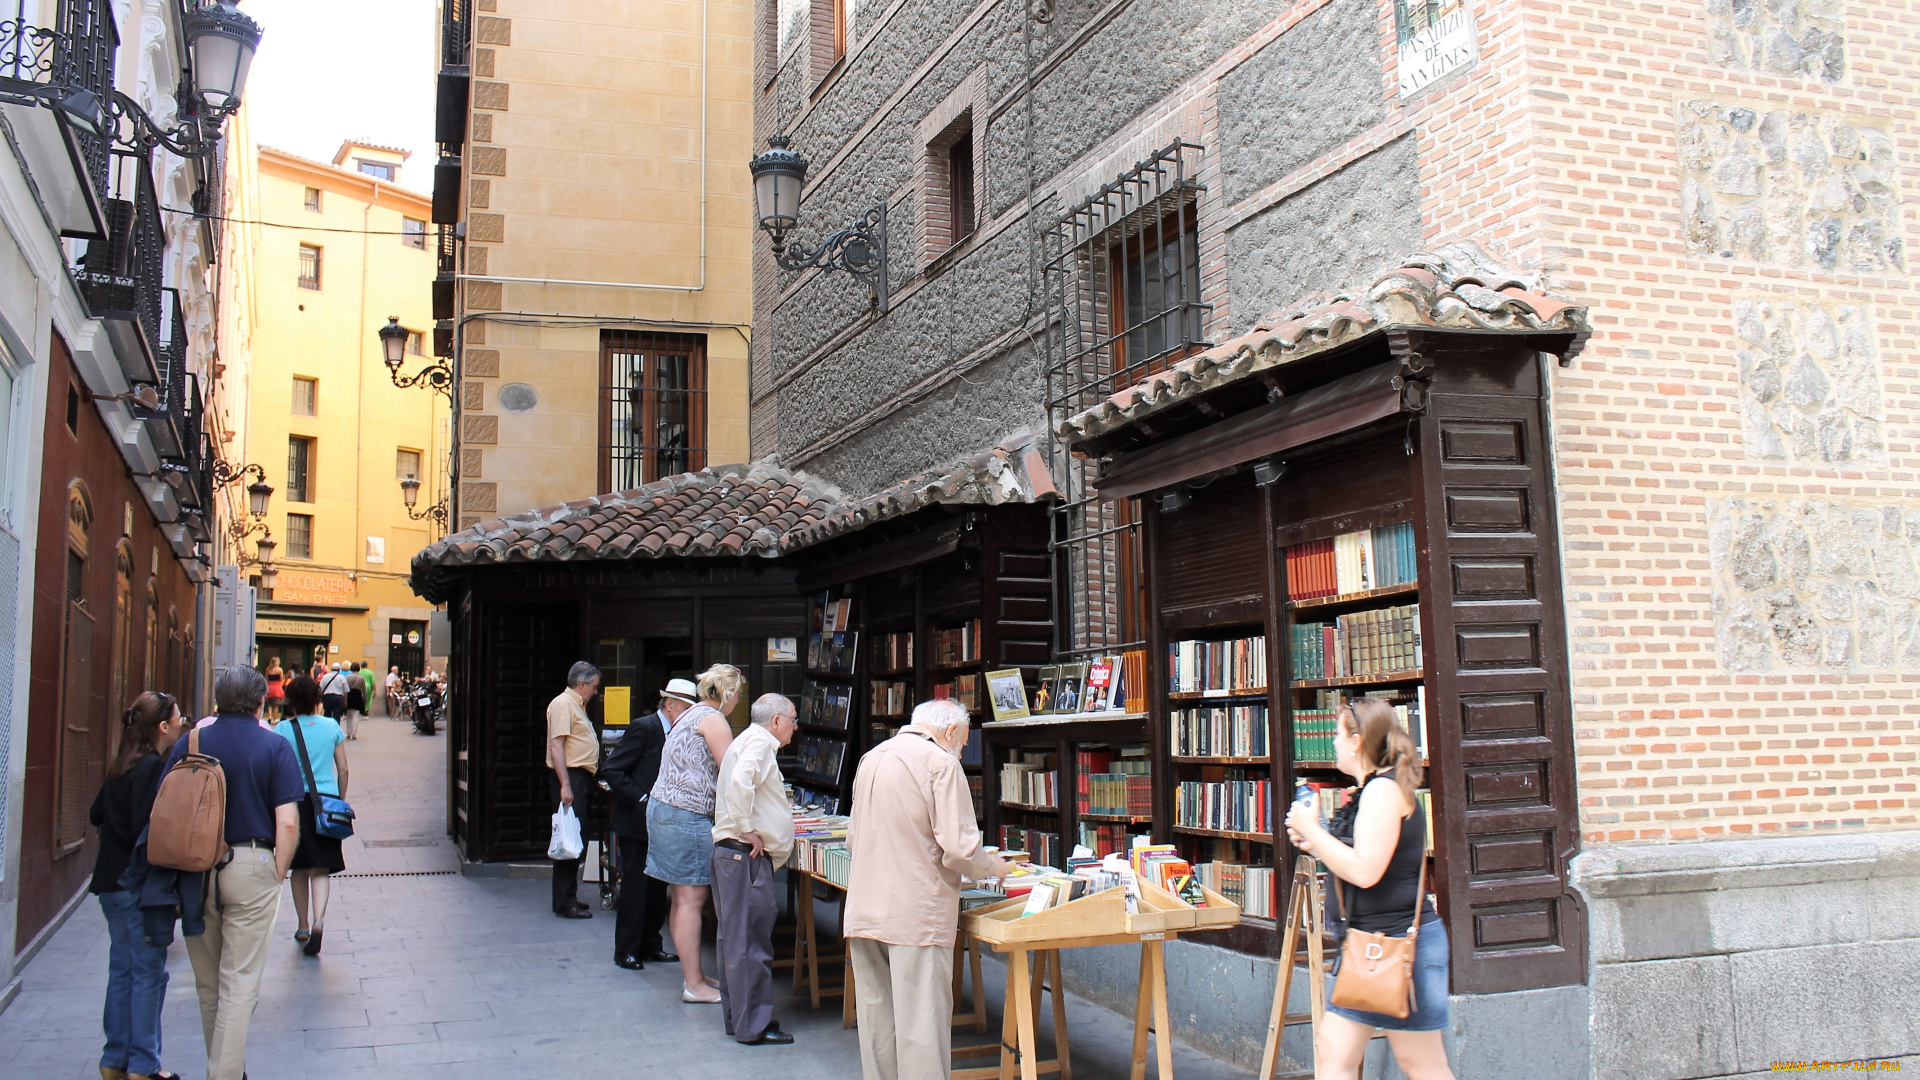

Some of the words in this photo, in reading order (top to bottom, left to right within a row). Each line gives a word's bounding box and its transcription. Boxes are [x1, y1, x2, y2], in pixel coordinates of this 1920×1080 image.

[1400, 9, 1464, 62] PASADIZO
[1425, 42, 1441, 62] DE
[1400, 65, 1428, 97] SAN
[274, 575, 354, 592] CHOCOLATERIA
[691, 567, 758, 584] GIN
[283, 592, 307, 602] SAN
[314, 594, 347, 605] GINES
